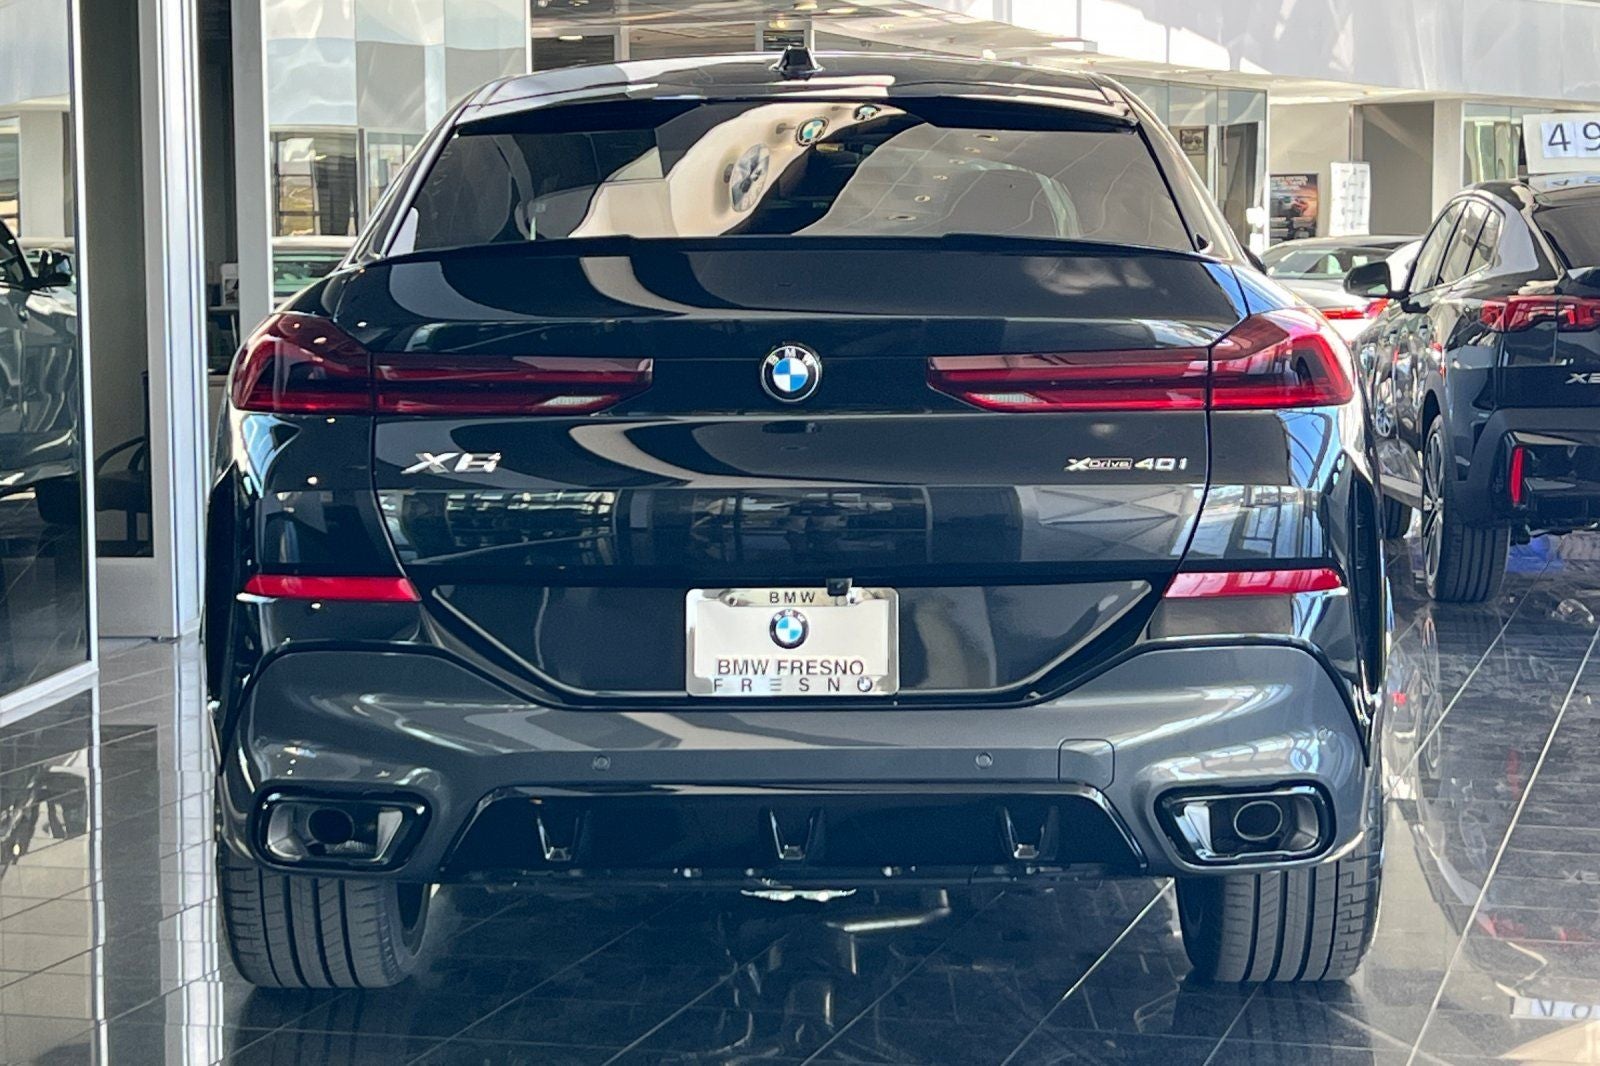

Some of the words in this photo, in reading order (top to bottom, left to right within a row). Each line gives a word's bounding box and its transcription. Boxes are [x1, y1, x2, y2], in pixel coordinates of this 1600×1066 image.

[769, 591, 816, 604] BMW
[717, 659, 770, 676] BMW
[777, 659, 865, 676] FRESNO
